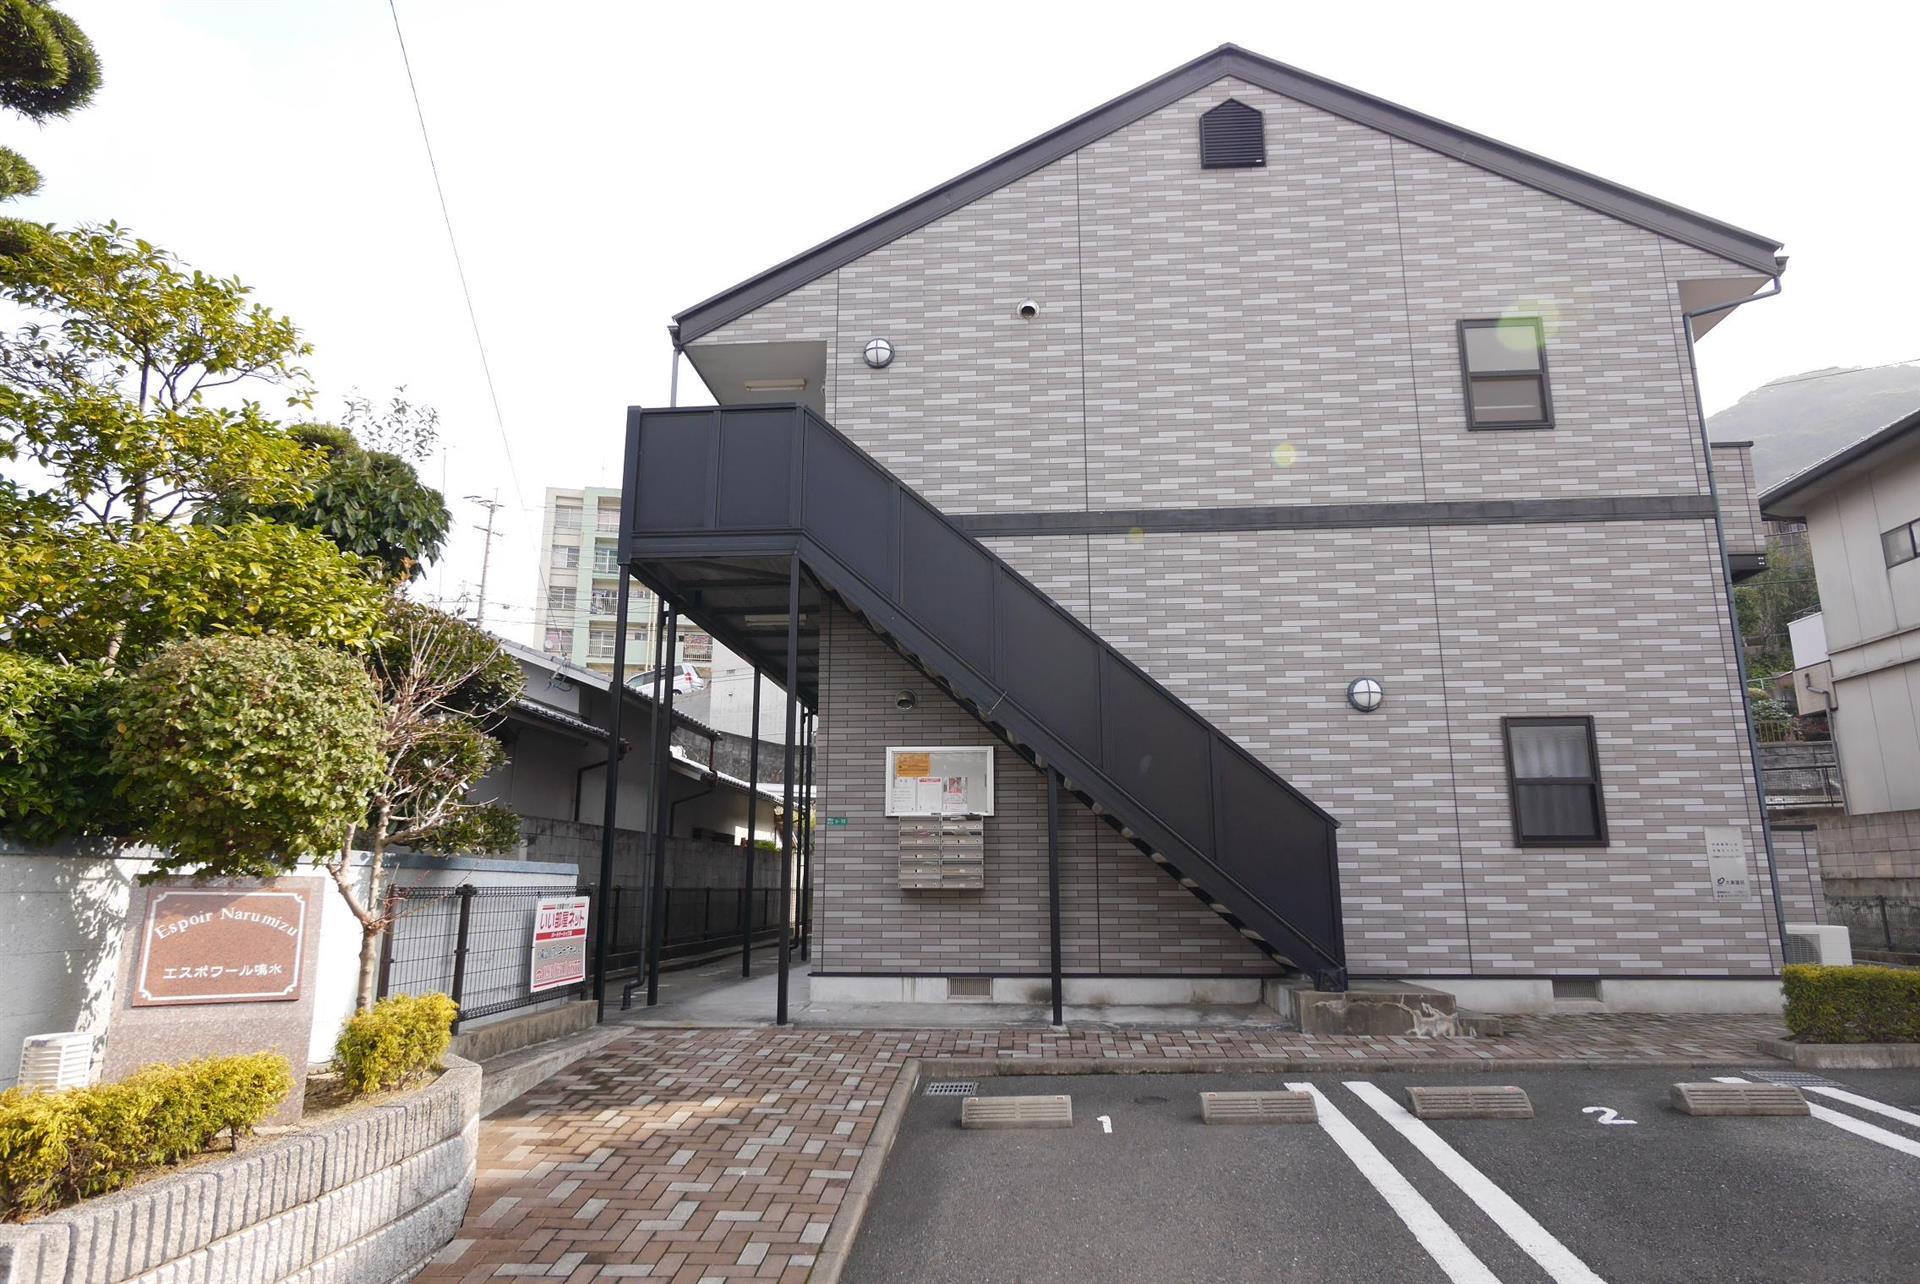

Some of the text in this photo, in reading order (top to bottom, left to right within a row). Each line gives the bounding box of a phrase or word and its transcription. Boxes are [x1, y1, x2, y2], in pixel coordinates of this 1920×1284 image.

[154, 906, 298, 940] Espoir Narumizu
[162, 963, 283, 980] エスポワール鳴水
[1096, 1115, 1113, 1134] 1
[1582, 1106, 1638, 1125] 2
